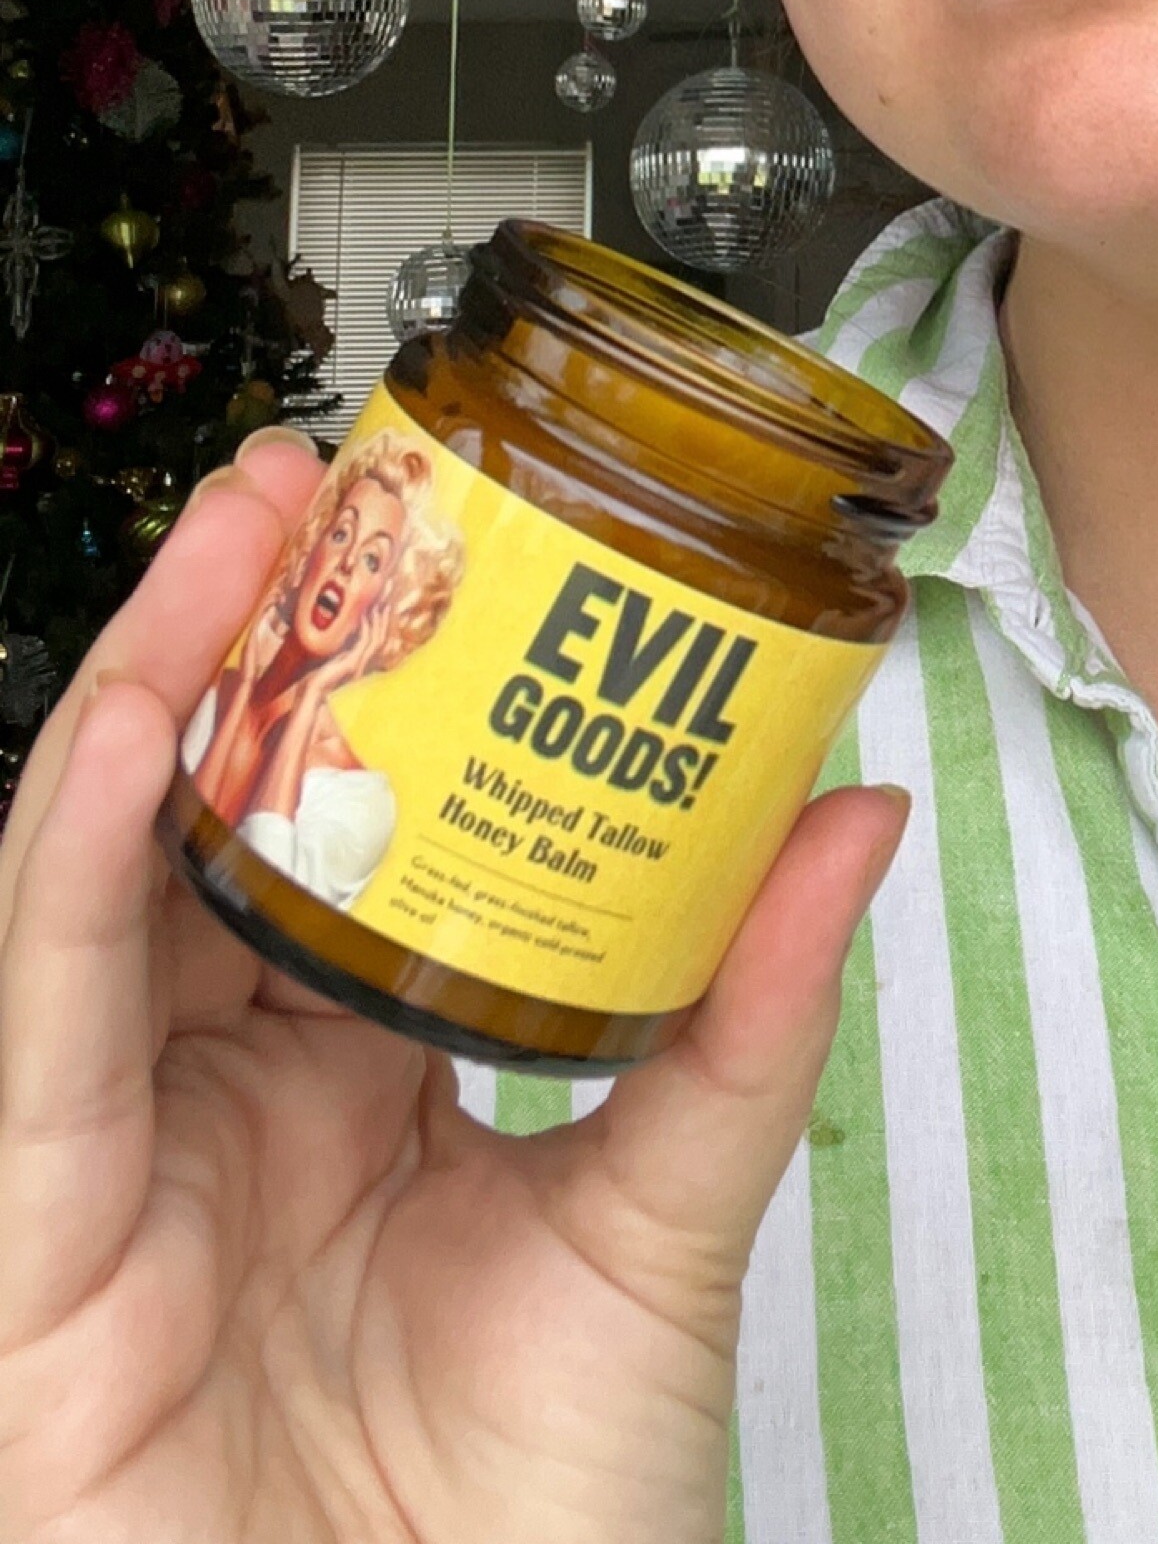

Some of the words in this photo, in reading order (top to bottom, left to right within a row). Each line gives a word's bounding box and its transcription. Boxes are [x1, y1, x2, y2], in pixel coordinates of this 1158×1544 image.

[524, 561, 759, 745] EVIL
[489, 674, 720, 811] GOODS!
[438, 793, 525, 856] Honey
[527, 834, 598, 884] Balm
[463, 755, 584, 833] Whipped
[586, 811, 670, 860] Tallow
